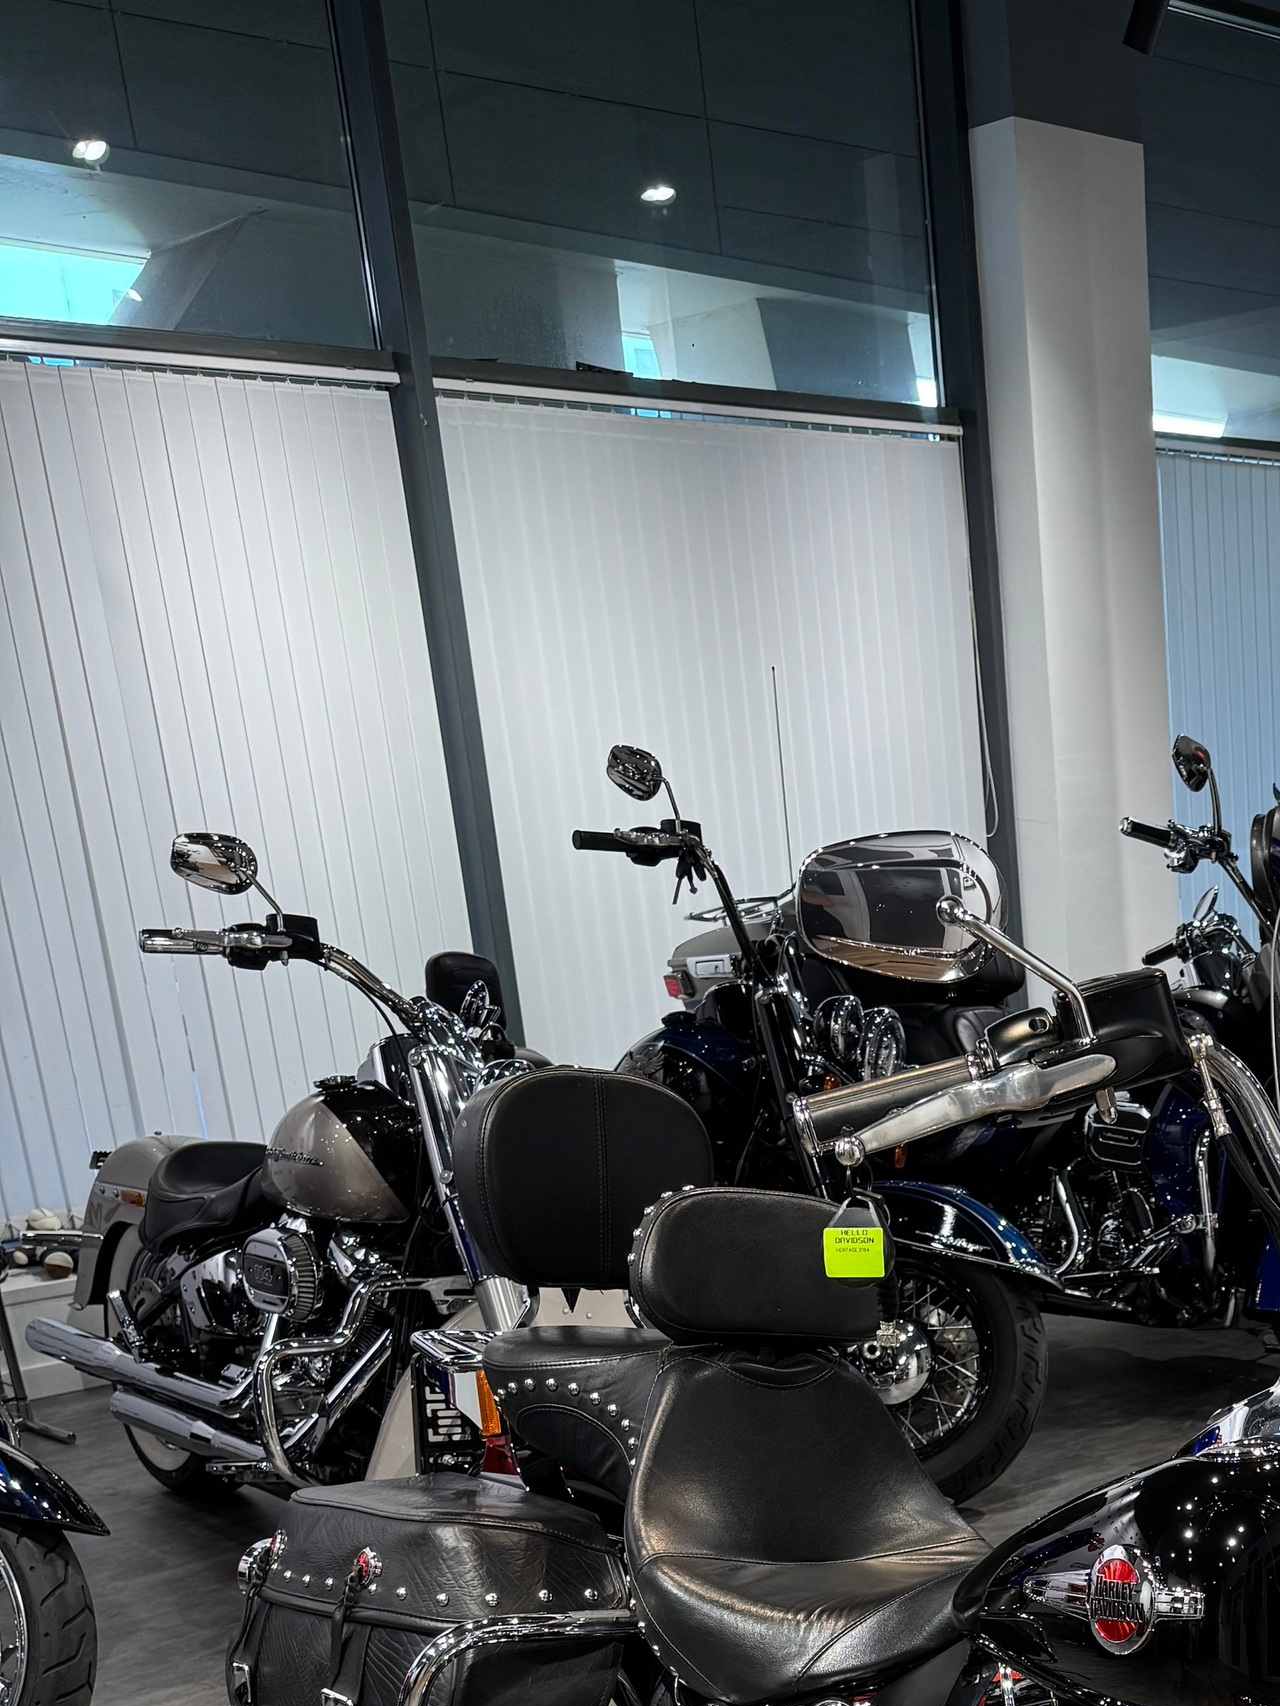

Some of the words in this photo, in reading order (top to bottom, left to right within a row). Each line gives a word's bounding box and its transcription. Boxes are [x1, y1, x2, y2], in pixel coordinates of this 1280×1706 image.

[840, 1229, 868, 1237] HELLO
[834, 1237, 875, 1245] DAVIDSON
[1090, 1597, 1145, 1624] DAVIDSON
